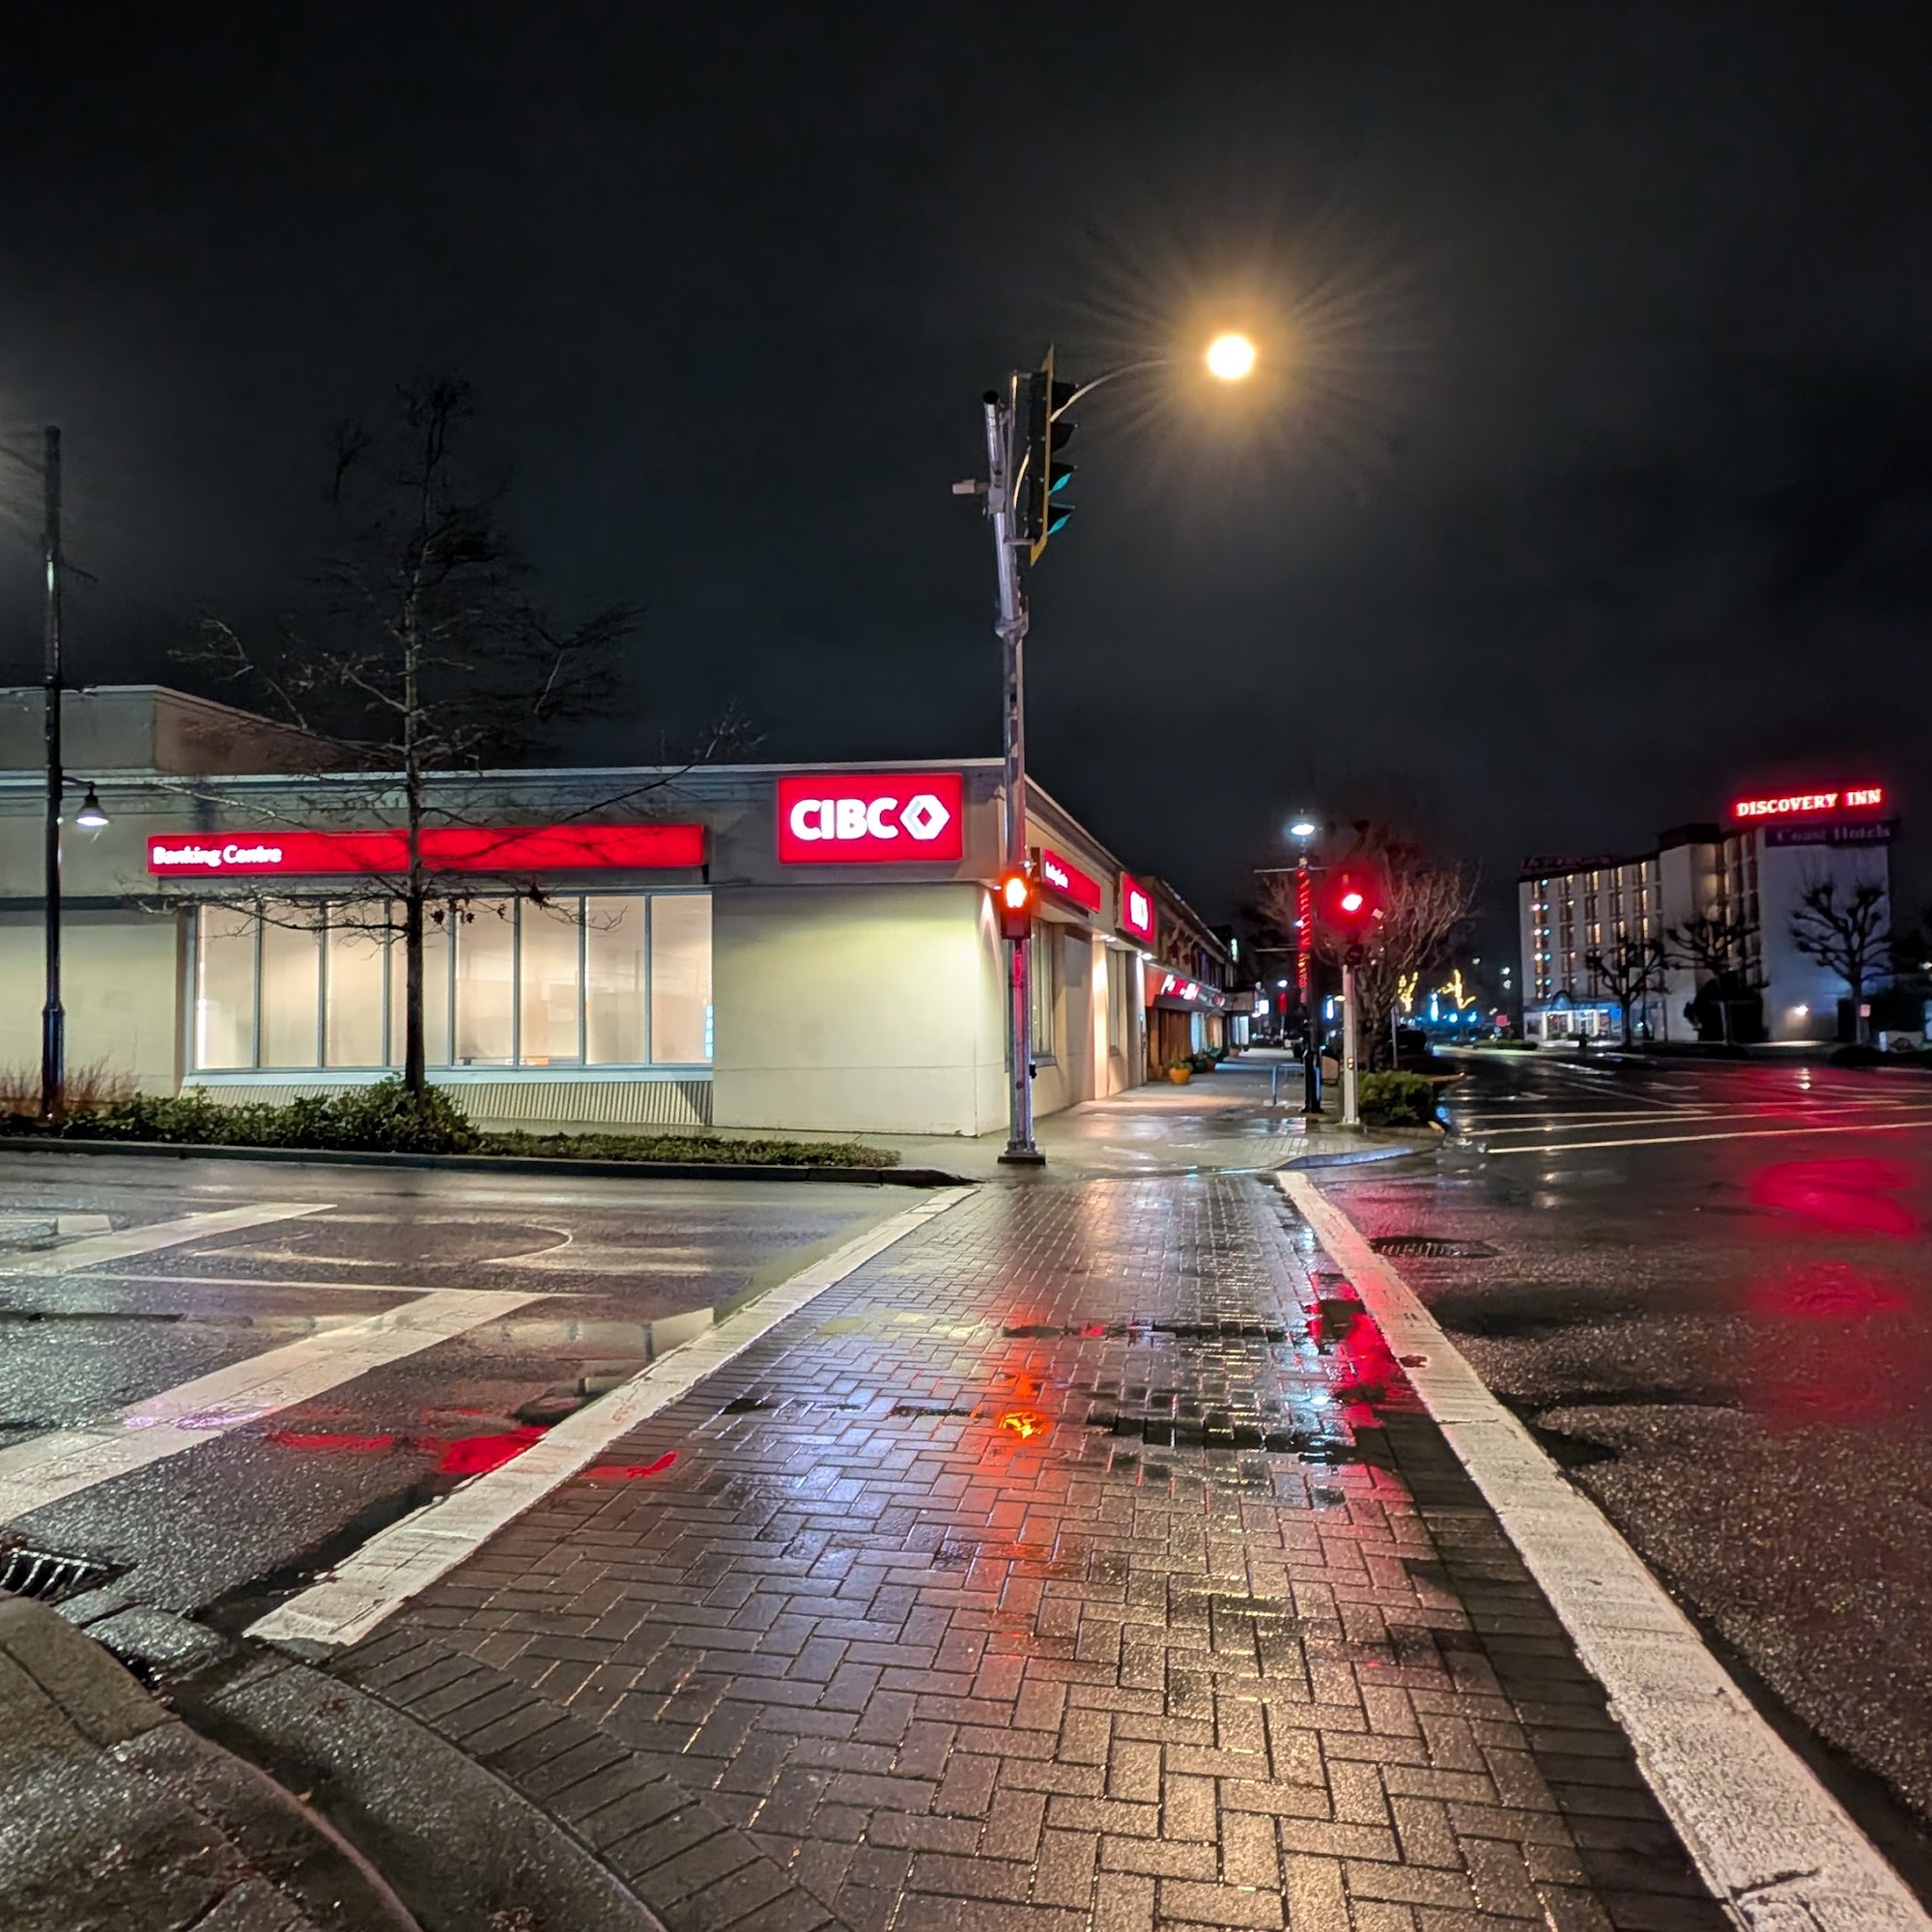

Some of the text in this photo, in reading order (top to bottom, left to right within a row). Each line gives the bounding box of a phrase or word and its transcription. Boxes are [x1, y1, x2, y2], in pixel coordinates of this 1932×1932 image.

[1736, 788, 1883, 816] DISCOVERY INN
[789, 797, 899, 841] CIBC
[152, 844, 283, 867] Banking Centre
